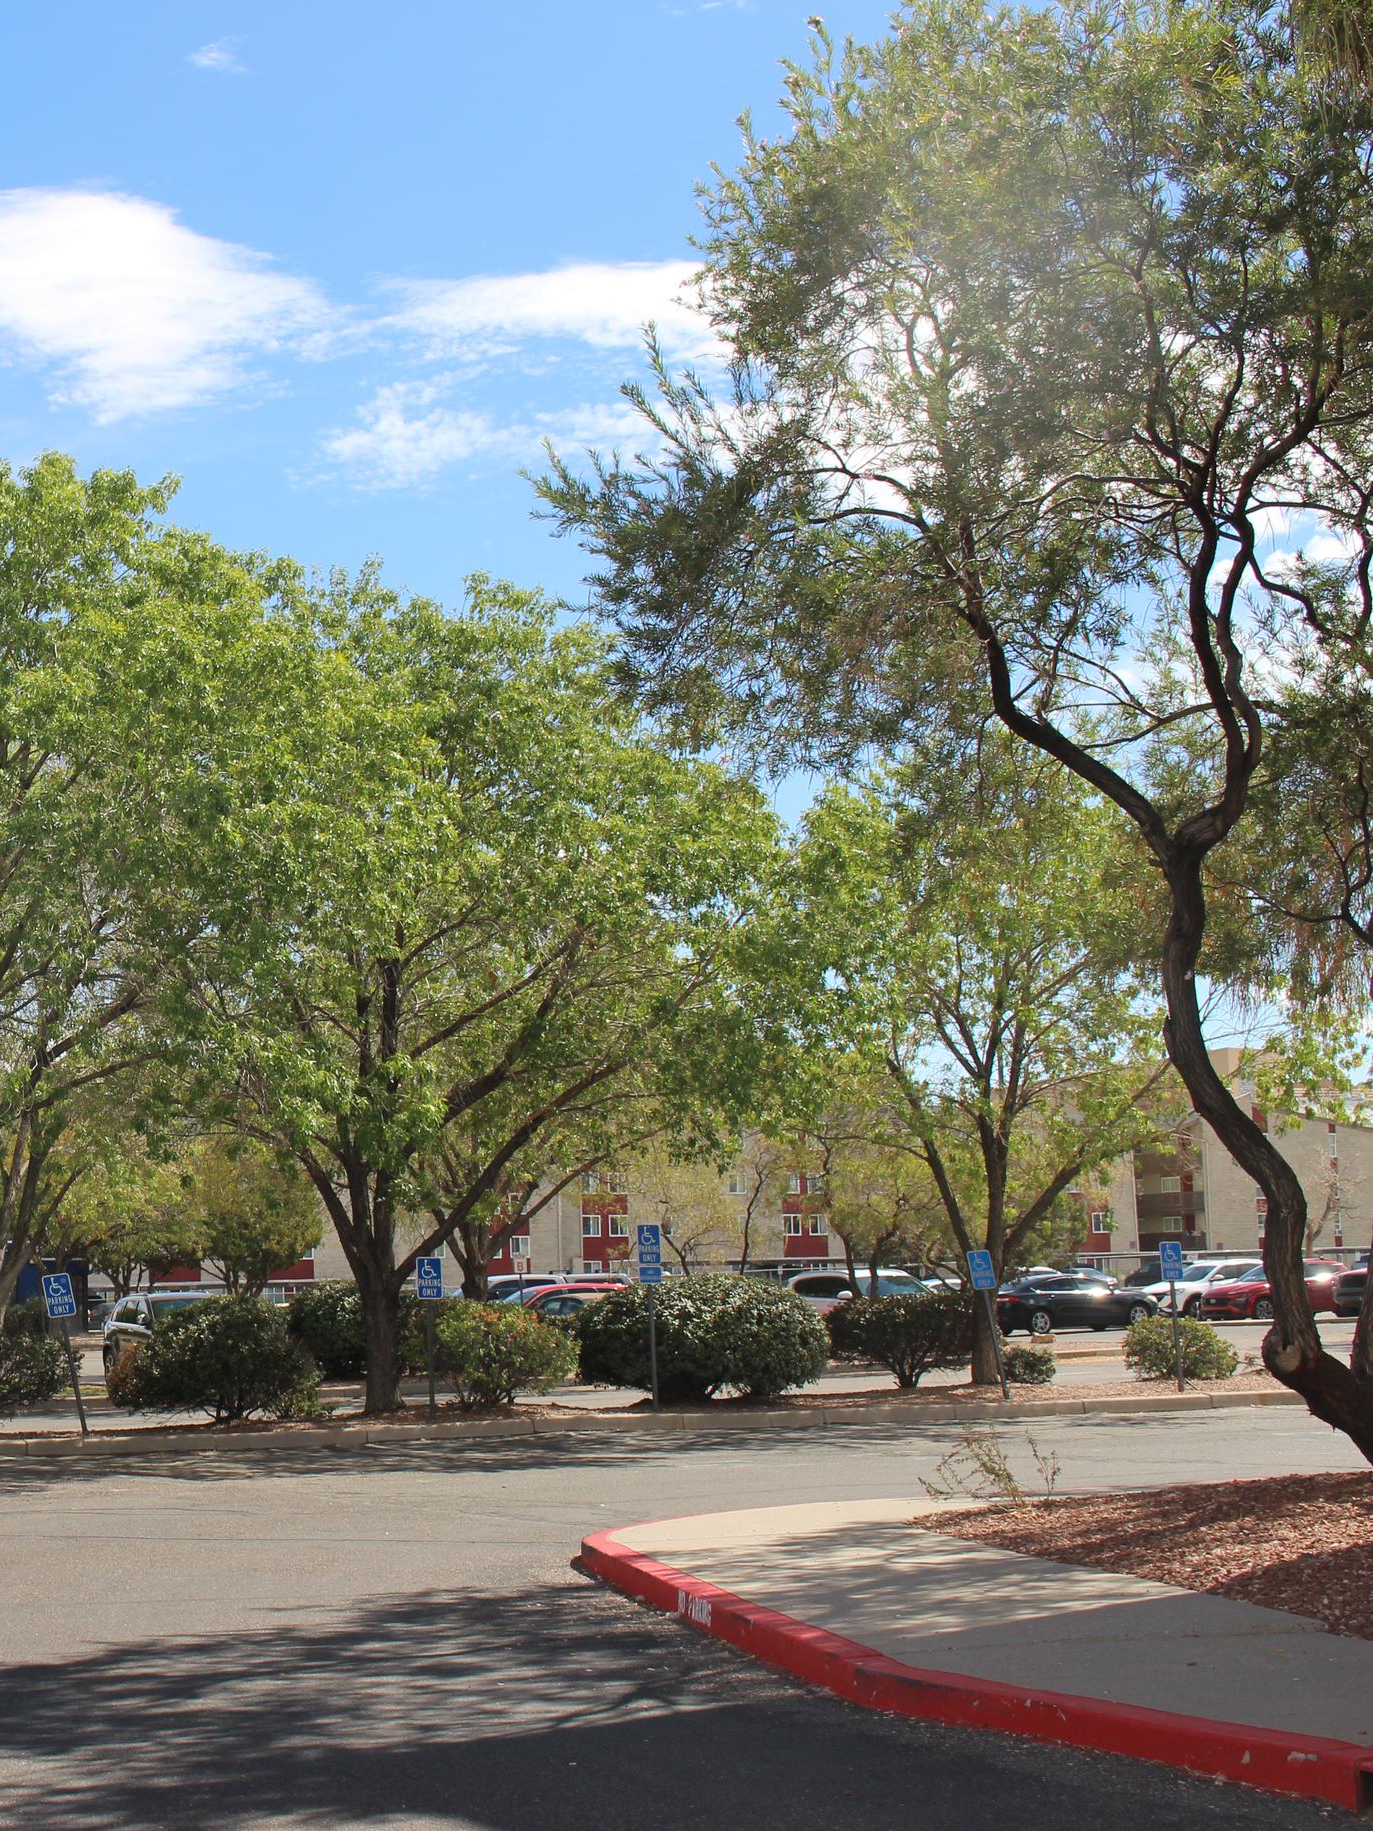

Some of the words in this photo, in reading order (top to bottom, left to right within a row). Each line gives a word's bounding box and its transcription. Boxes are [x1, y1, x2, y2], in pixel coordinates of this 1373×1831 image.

[643, 1254, 657, 1262] ONLY
[419, 1279, 441, 1287] PARKING
[48, 1295, 72, 1304] PARKING
[54, 1306, 69, 1314] ONLY
